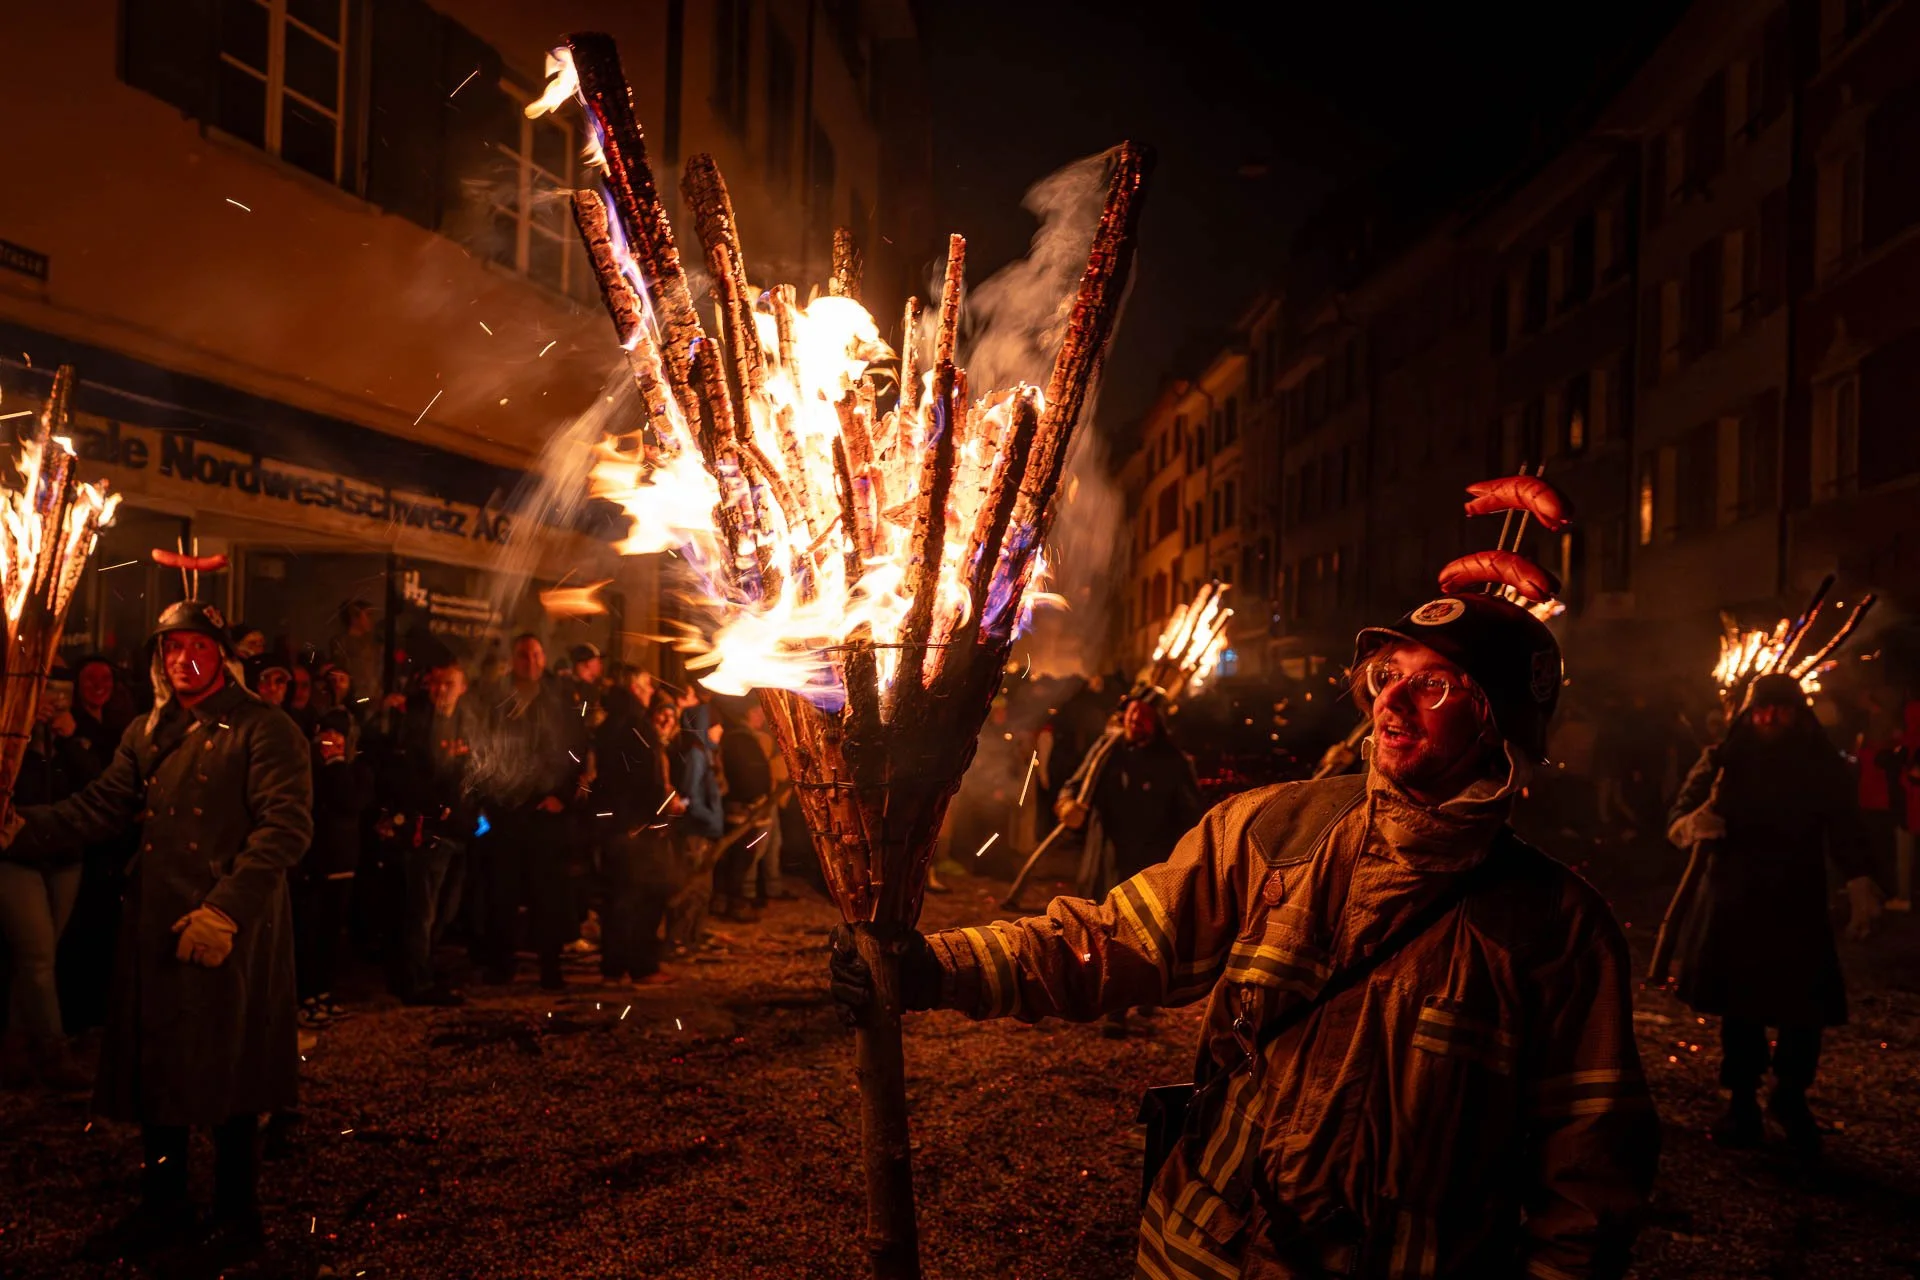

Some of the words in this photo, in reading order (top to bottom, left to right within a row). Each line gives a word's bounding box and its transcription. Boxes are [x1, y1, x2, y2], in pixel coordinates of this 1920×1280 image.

[78, 418, 149, 468] ale
[159, 430, 468, 537] Nordwestschweiz
[472, 505, 512, 544] AG
